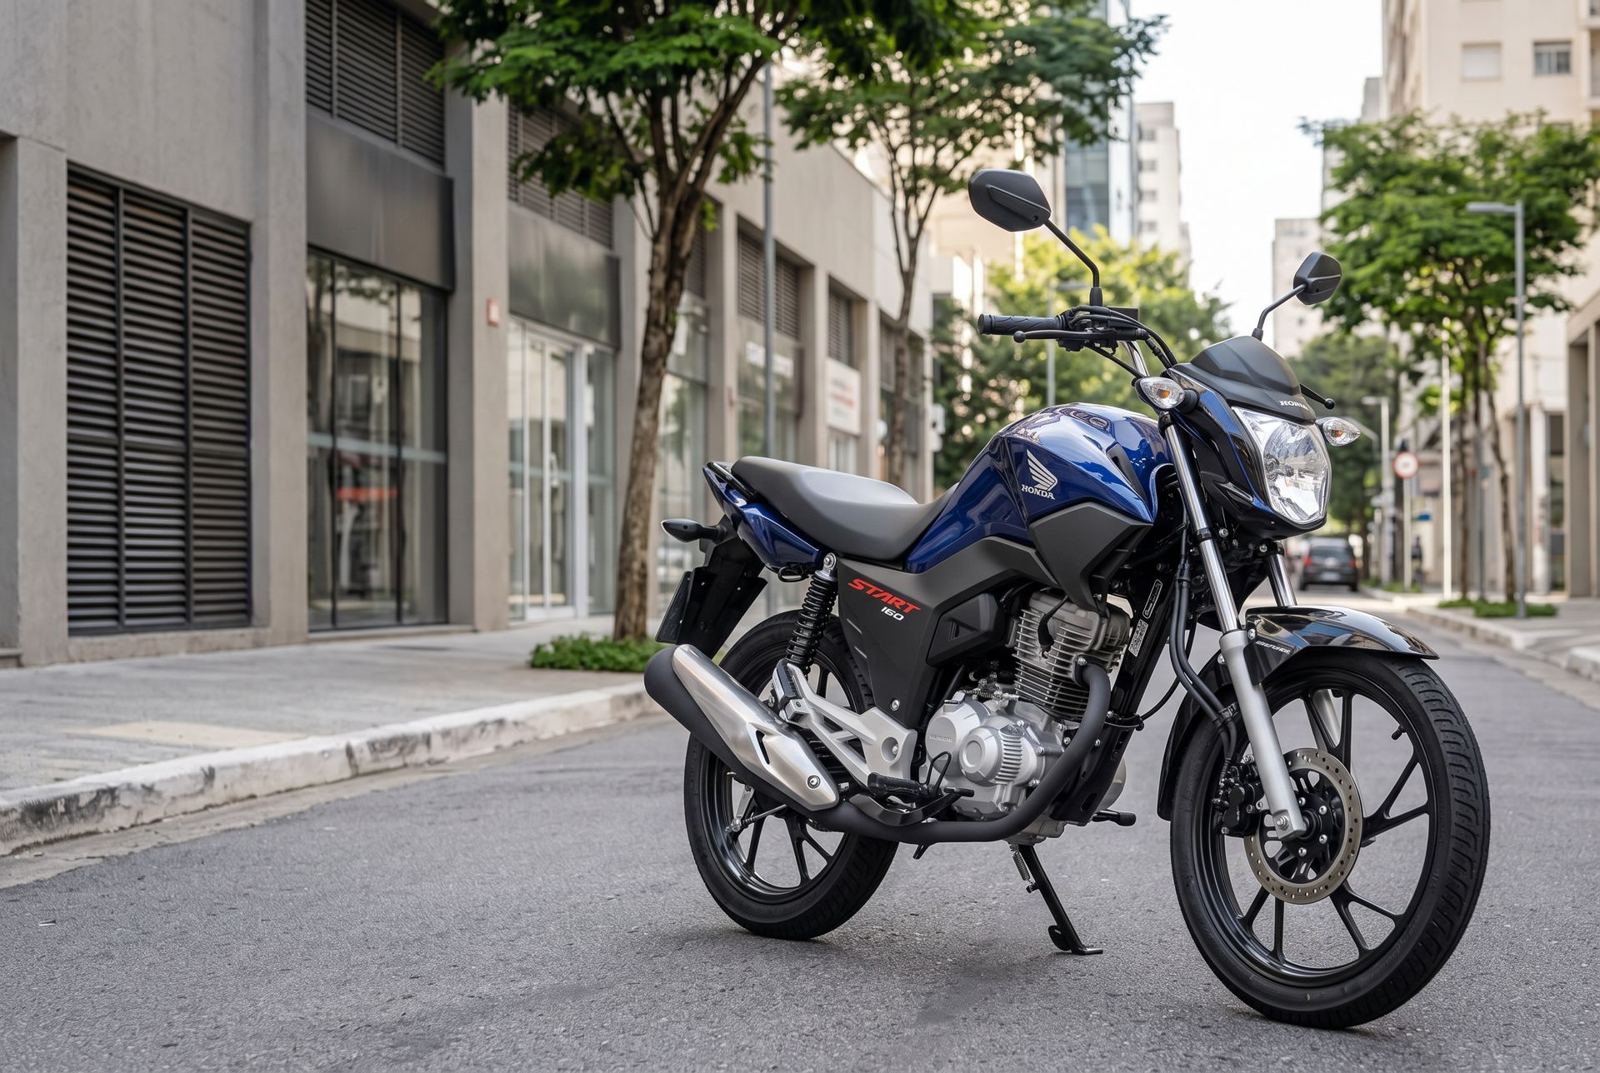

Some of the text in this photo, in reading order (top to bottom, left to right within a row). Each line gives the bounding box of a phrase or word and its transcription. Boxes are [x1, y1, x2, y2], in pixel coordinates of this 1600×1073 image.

[1021, 483, 1056, 500] HONDA
[847, 578, 921, 614] START
[881, 606, 904, 621] 160
